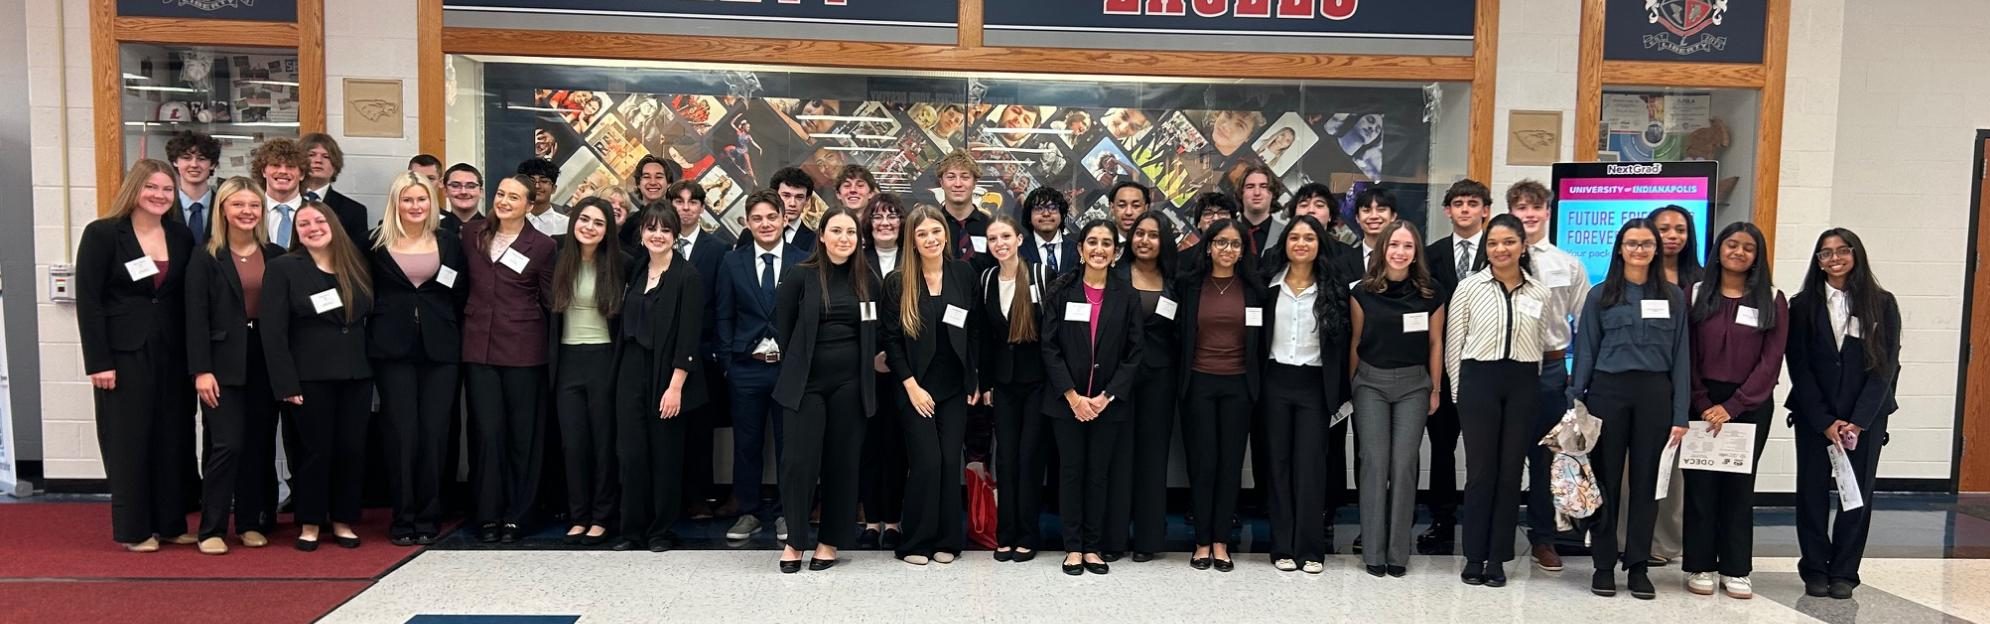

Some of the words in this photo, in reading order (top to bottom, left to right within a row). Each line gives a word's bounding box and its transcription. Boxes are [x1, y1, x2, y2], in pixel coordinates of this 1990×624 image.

[1607, 163, 1661, 175] NextGrad
[1569, 185, 1624, 194] UNIVERSITY
[1632, 185, 1697, 194] INDIANAPOLIS
[1568, 211, 1615, 226] FUTURE
[1567, 230, 1617, 245] FOREVE
